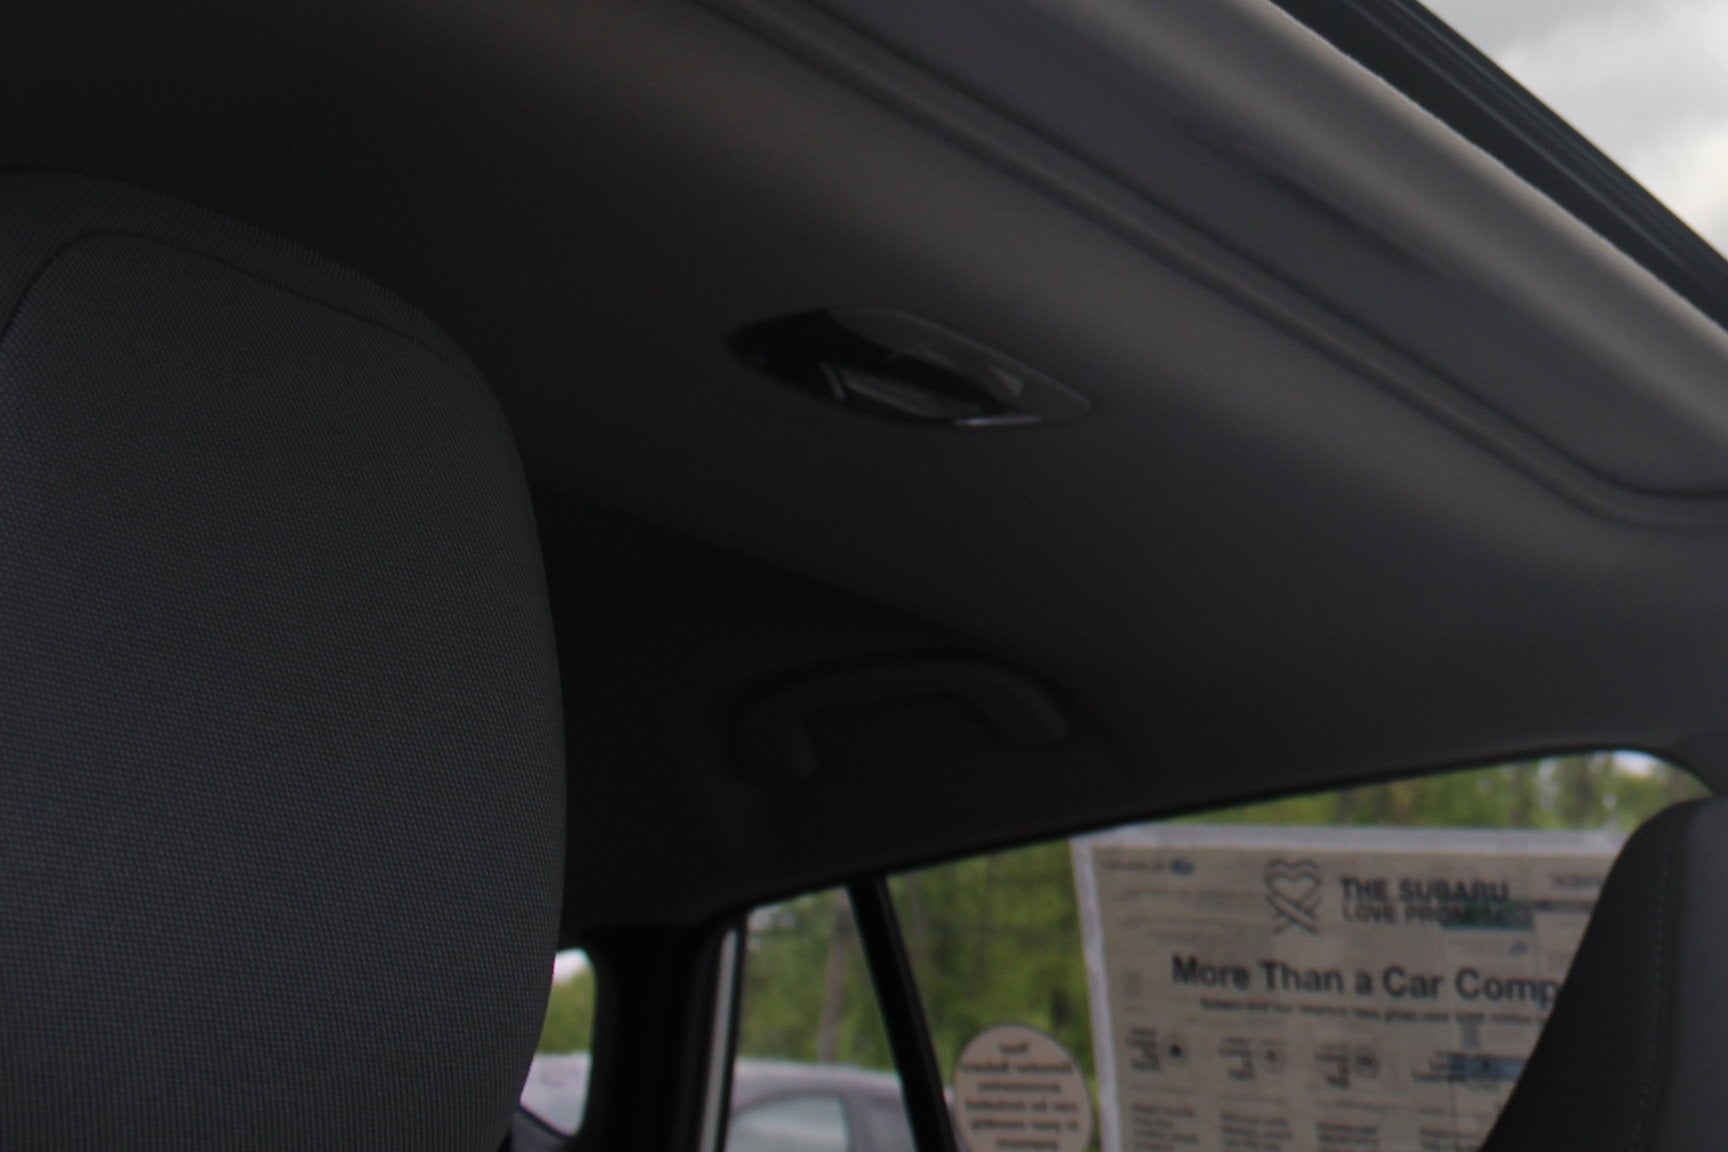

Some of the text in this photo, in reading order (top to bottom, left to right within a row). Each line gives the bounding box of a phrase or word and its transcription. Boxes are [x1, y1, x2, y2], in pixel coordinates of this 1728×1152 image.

[1340, 877, 1510, 903] THE SUBARU
[1172, 954, 1250, 990] More
[1258, 960, 1345, 994] Than
[1355, 969, 1373, 995] a
[1382, 965, 1443, 998] Car
